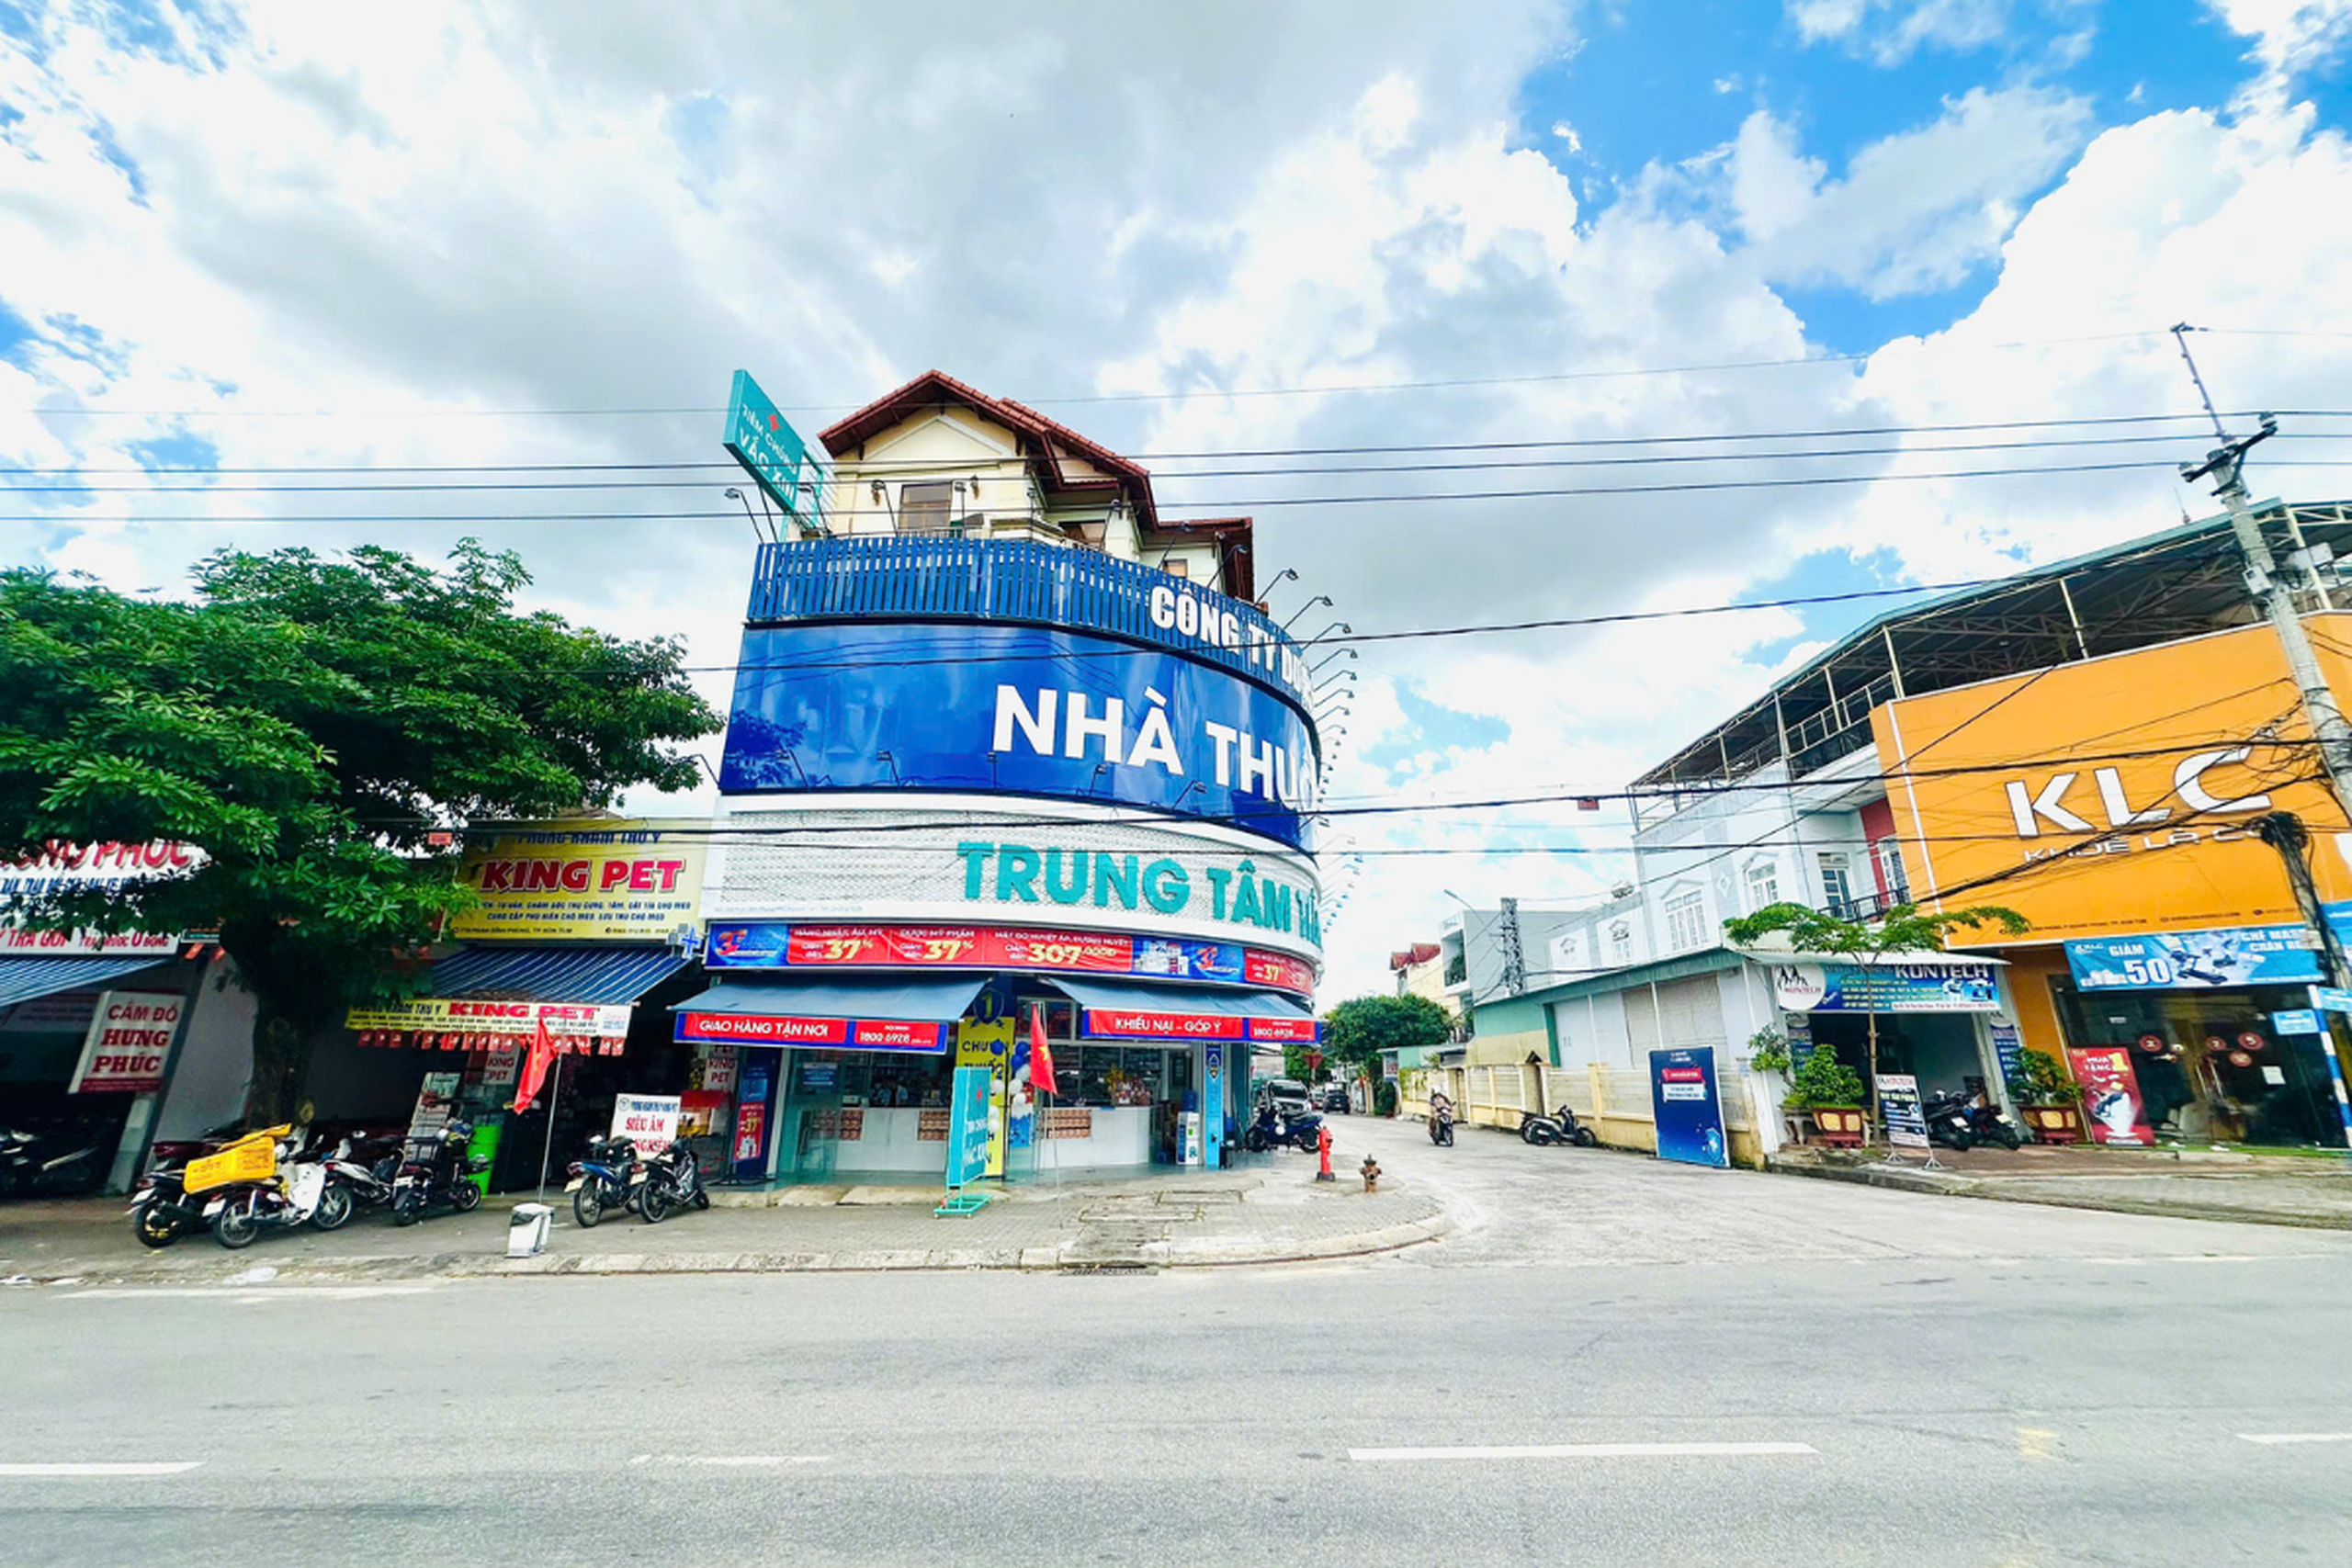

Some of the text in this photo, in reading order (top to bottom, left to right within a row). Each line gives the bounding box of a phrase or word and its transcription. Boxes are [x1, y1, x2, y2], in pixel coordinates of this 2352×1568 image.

[1151, 582, 1239, 656] CÔNG
[1248, 623, 1274, 671] TY
[993, 684, 1185, 776] NHÀ
[2004, 746, 2274, 840] KLC
[481, 859, 684, 892] KING PET
[956, 840, 1192, 914] TRUNG
[1206, 859, 1292, 933] TÂM
[1894, 963, 1990, 980] KONTECH
[2122, 957, 2171, 986] 50
[447, 1002, 530, 1018] KING
[537, 1005, 598, 1021] PET
[1114, 1014, 1148, 1031] KHIẾU
[1152, 1019, 1173, 1034] NẠI
[1183, 1020, 1210, 1032] GÓP
[1214, 1021, 1222, 1033] Ý
[699, 1019, 829, 1038] GIAO HÀNG TẬN NƠI
